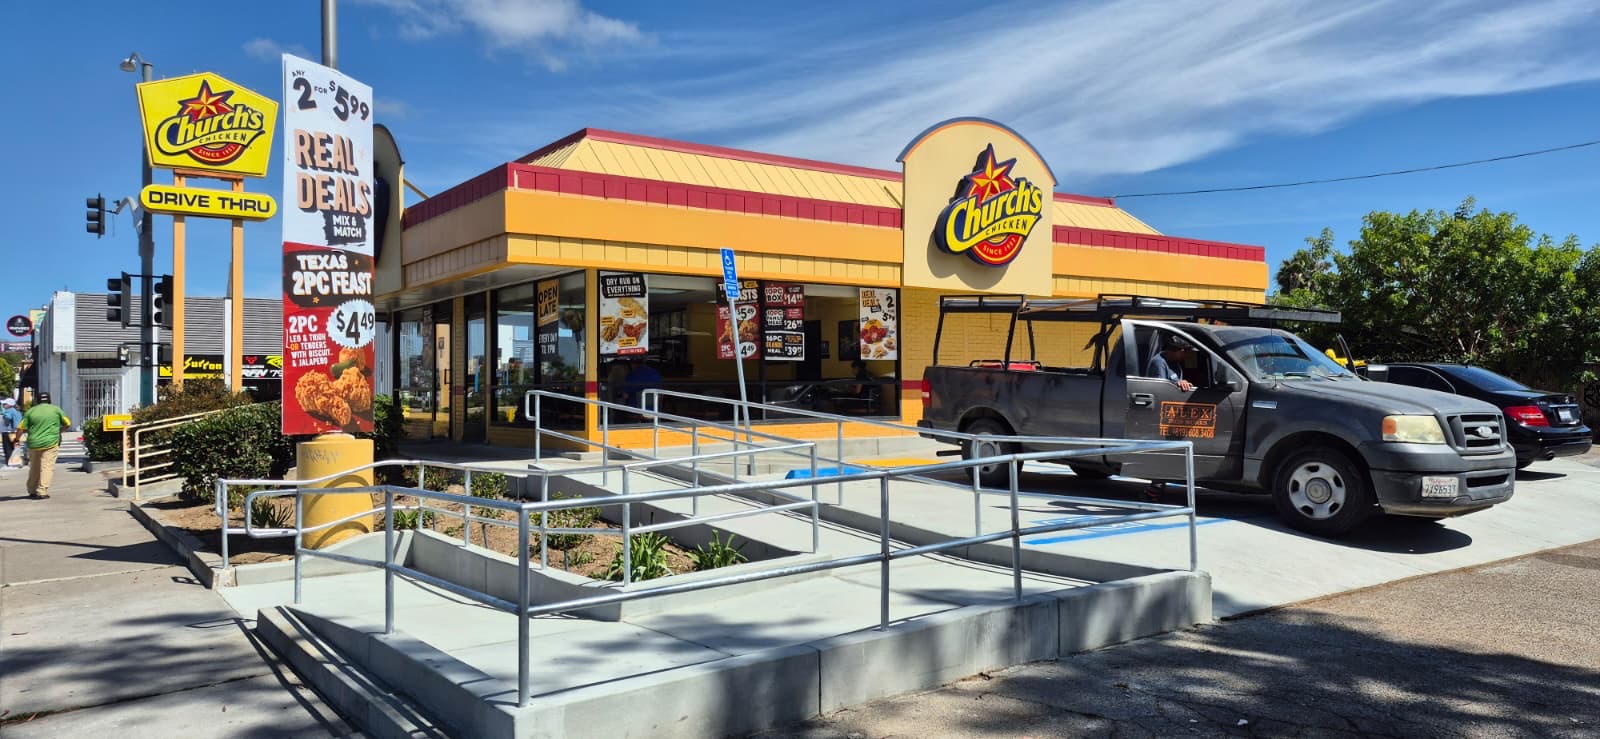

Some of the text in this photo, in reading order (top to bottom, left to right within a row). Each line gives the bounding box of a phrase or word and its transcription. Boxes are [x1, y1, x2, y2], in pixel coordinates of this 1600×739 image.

[292, 69, 305, 77] ANY
[293, 77, 317, 110] 2
[314, 86, 328, 94] FOR
[157, 104, 264, 154] Church's
[198, 133, 247, 144] CHICKEN
[198, 149, 221, 158] SINCE
[294, 128, 359, 176] REAL
[148, 190, 271, 213] DRIVE THRU
[296, 172, 372, 219] DEALS
[332, 215, 357, 226] MIX &
[945, 180, 1042, 252] Church's
[333, 226, 362, 238] MATCH
[985, 219, 1028, 236] CHICKEN
[983, 245, 1003, 256] SINCE
[297, 255, 348, 270] TEXAS
[292, 271, 372, 295] 2PC FEAST
[606, 278, 618, 286] DRY
[538, 284, 558, 303] OPEN
[607, 284, 641, 294] EVERYTHING
[767, 294, 782, 302] BOX
[886, 296, 894, 308] 2
[540, 300, 557, 318] LATE
[289, 315, 318, 333] 2PC
[289, 334, 301, 343] LEG
[309, 333, 326, 342] THIGH
[290, 341, 326, 350] OR TENDERS
[291, 351, 307, 359] WITH
[1167, 406, 1210, 418] ALEX
